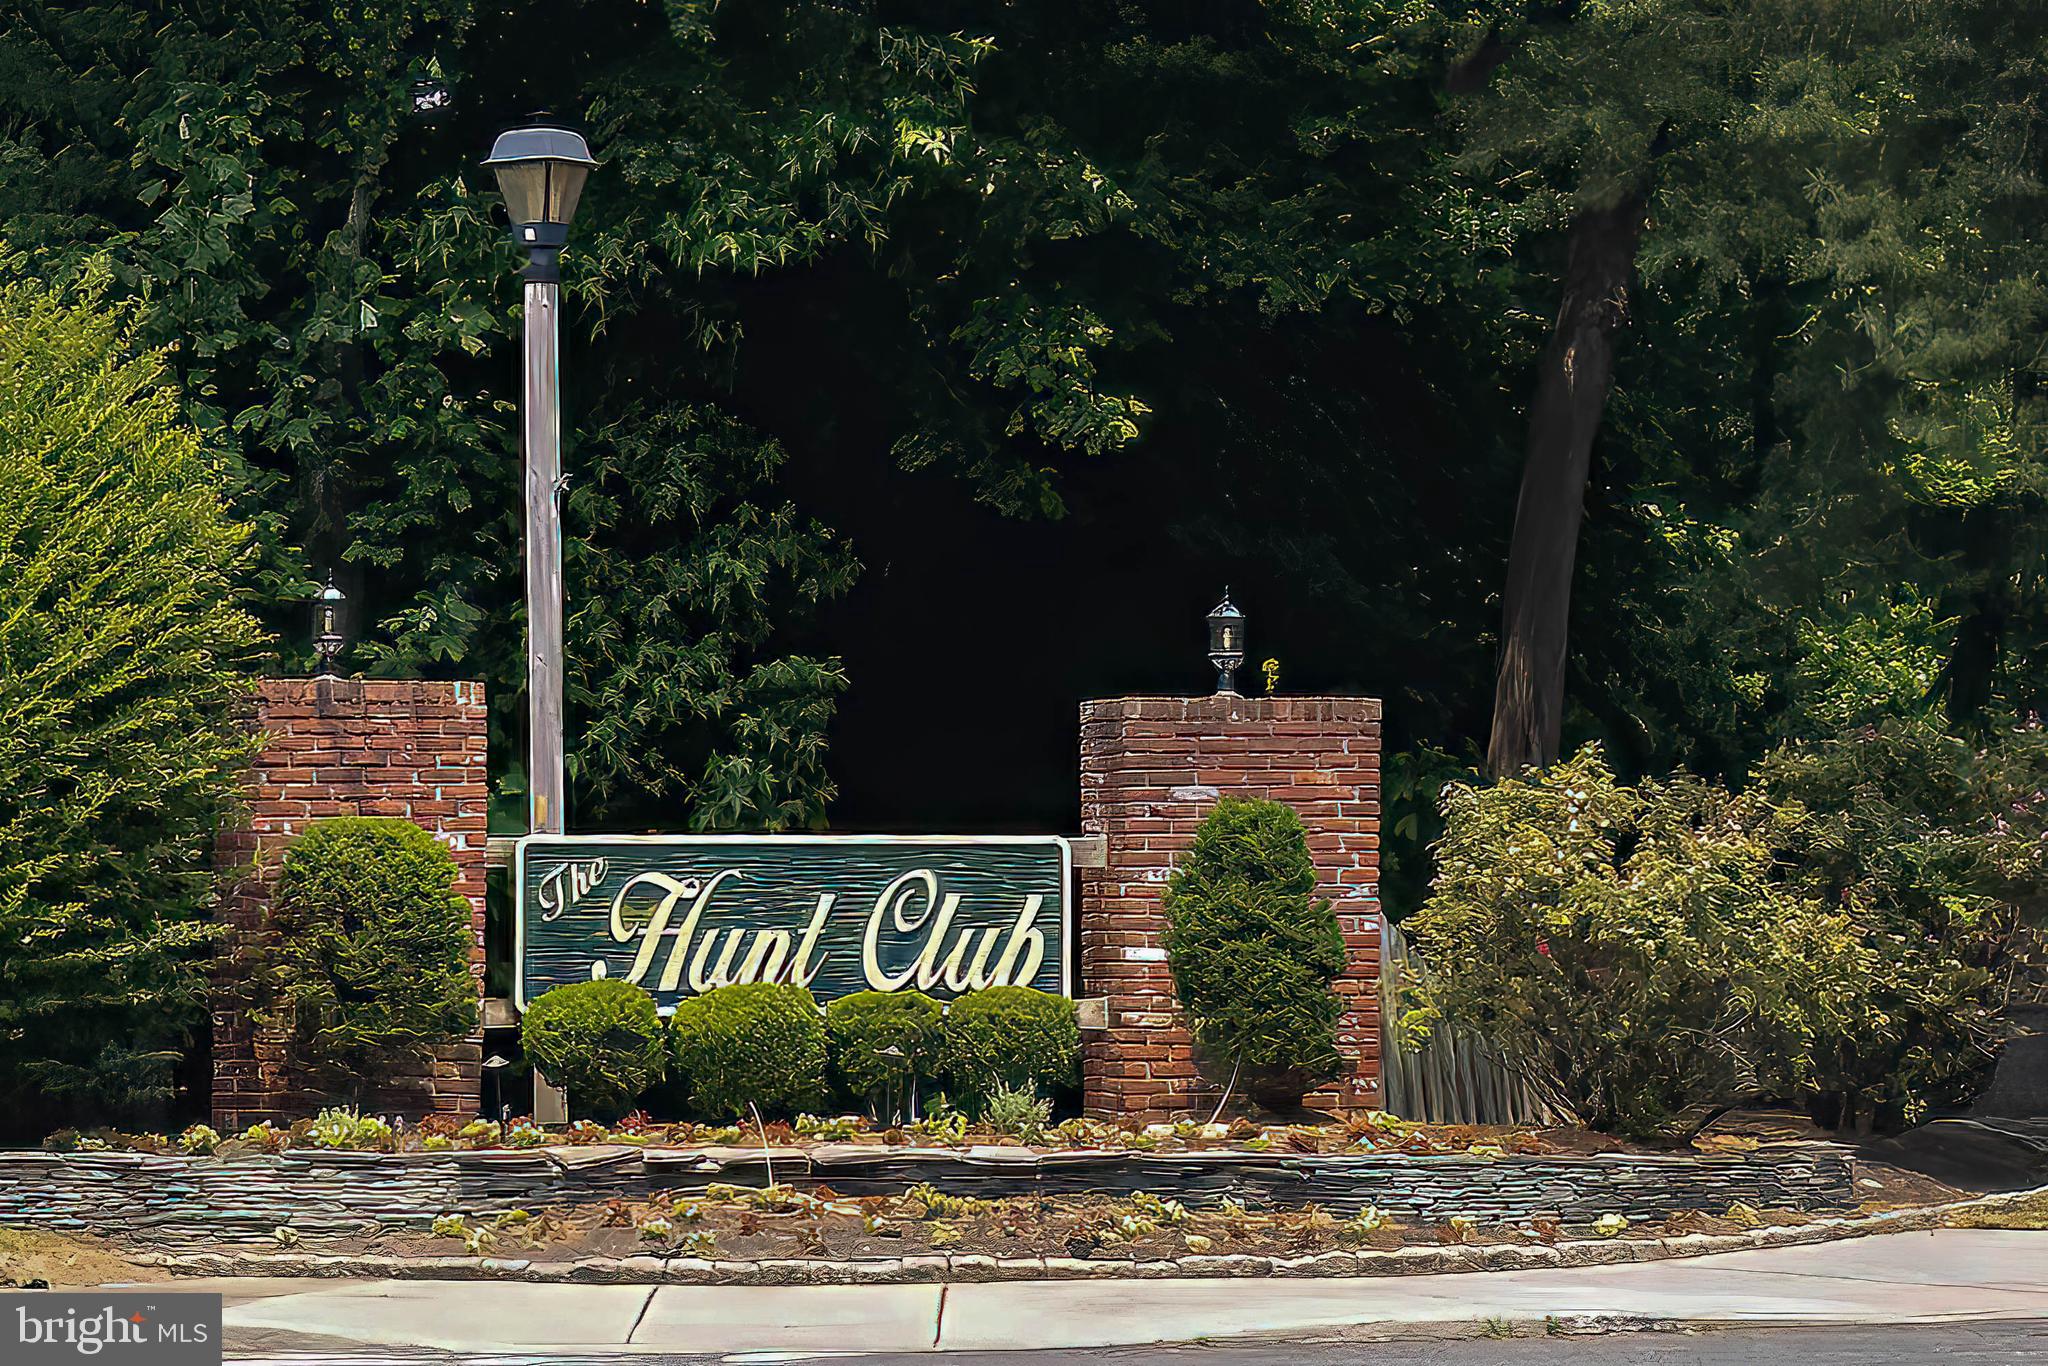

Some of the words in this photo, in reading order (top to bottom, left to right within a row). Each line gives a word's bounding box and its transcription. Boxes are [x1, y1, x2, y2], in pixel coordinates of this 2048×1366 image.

[539, 856, 609, 922] The
[591, 868, 838, 992] Hunt
[862, 868, 1046, 993] Club
